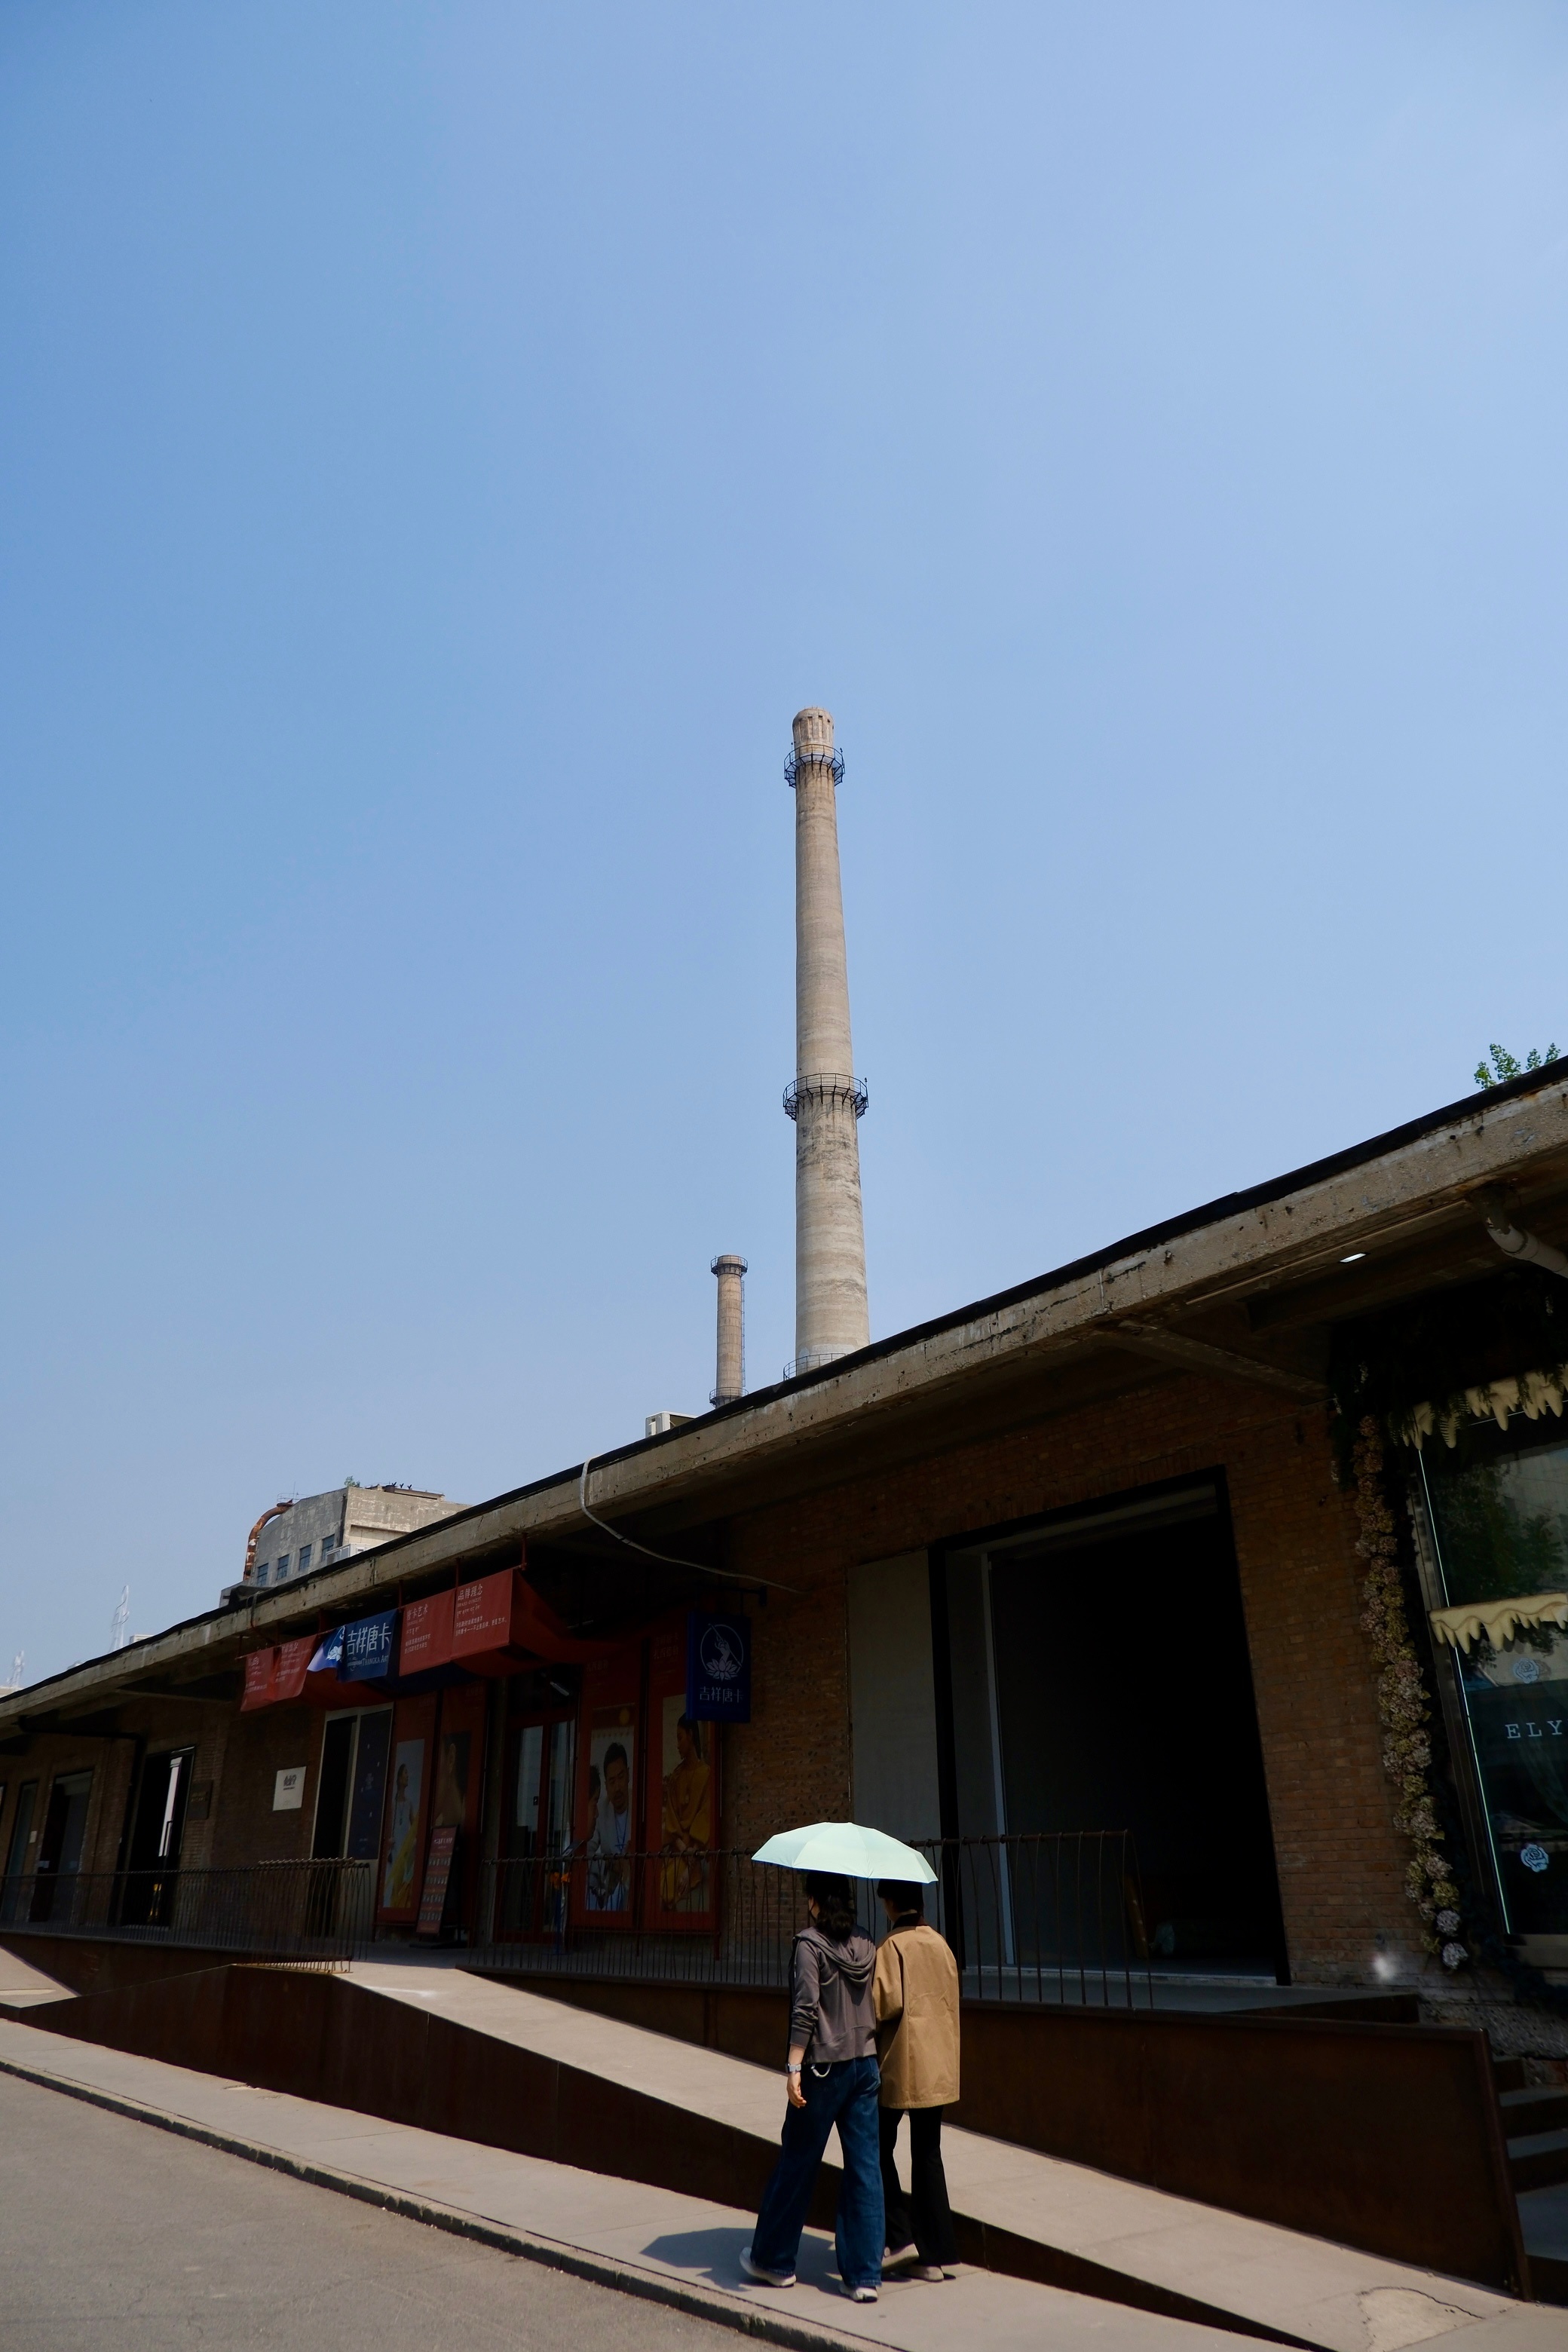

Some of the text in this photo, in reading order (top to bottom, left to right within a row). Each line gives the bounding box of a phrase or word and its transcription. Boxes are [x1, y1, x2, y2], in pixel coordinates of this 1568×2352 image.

[347, 1622, 392, 1658] 吉祥唐卡
[700, 1686, 744, 1704] 吉祥唐卡
[1505, 1720, 1563, 1739] ELY
